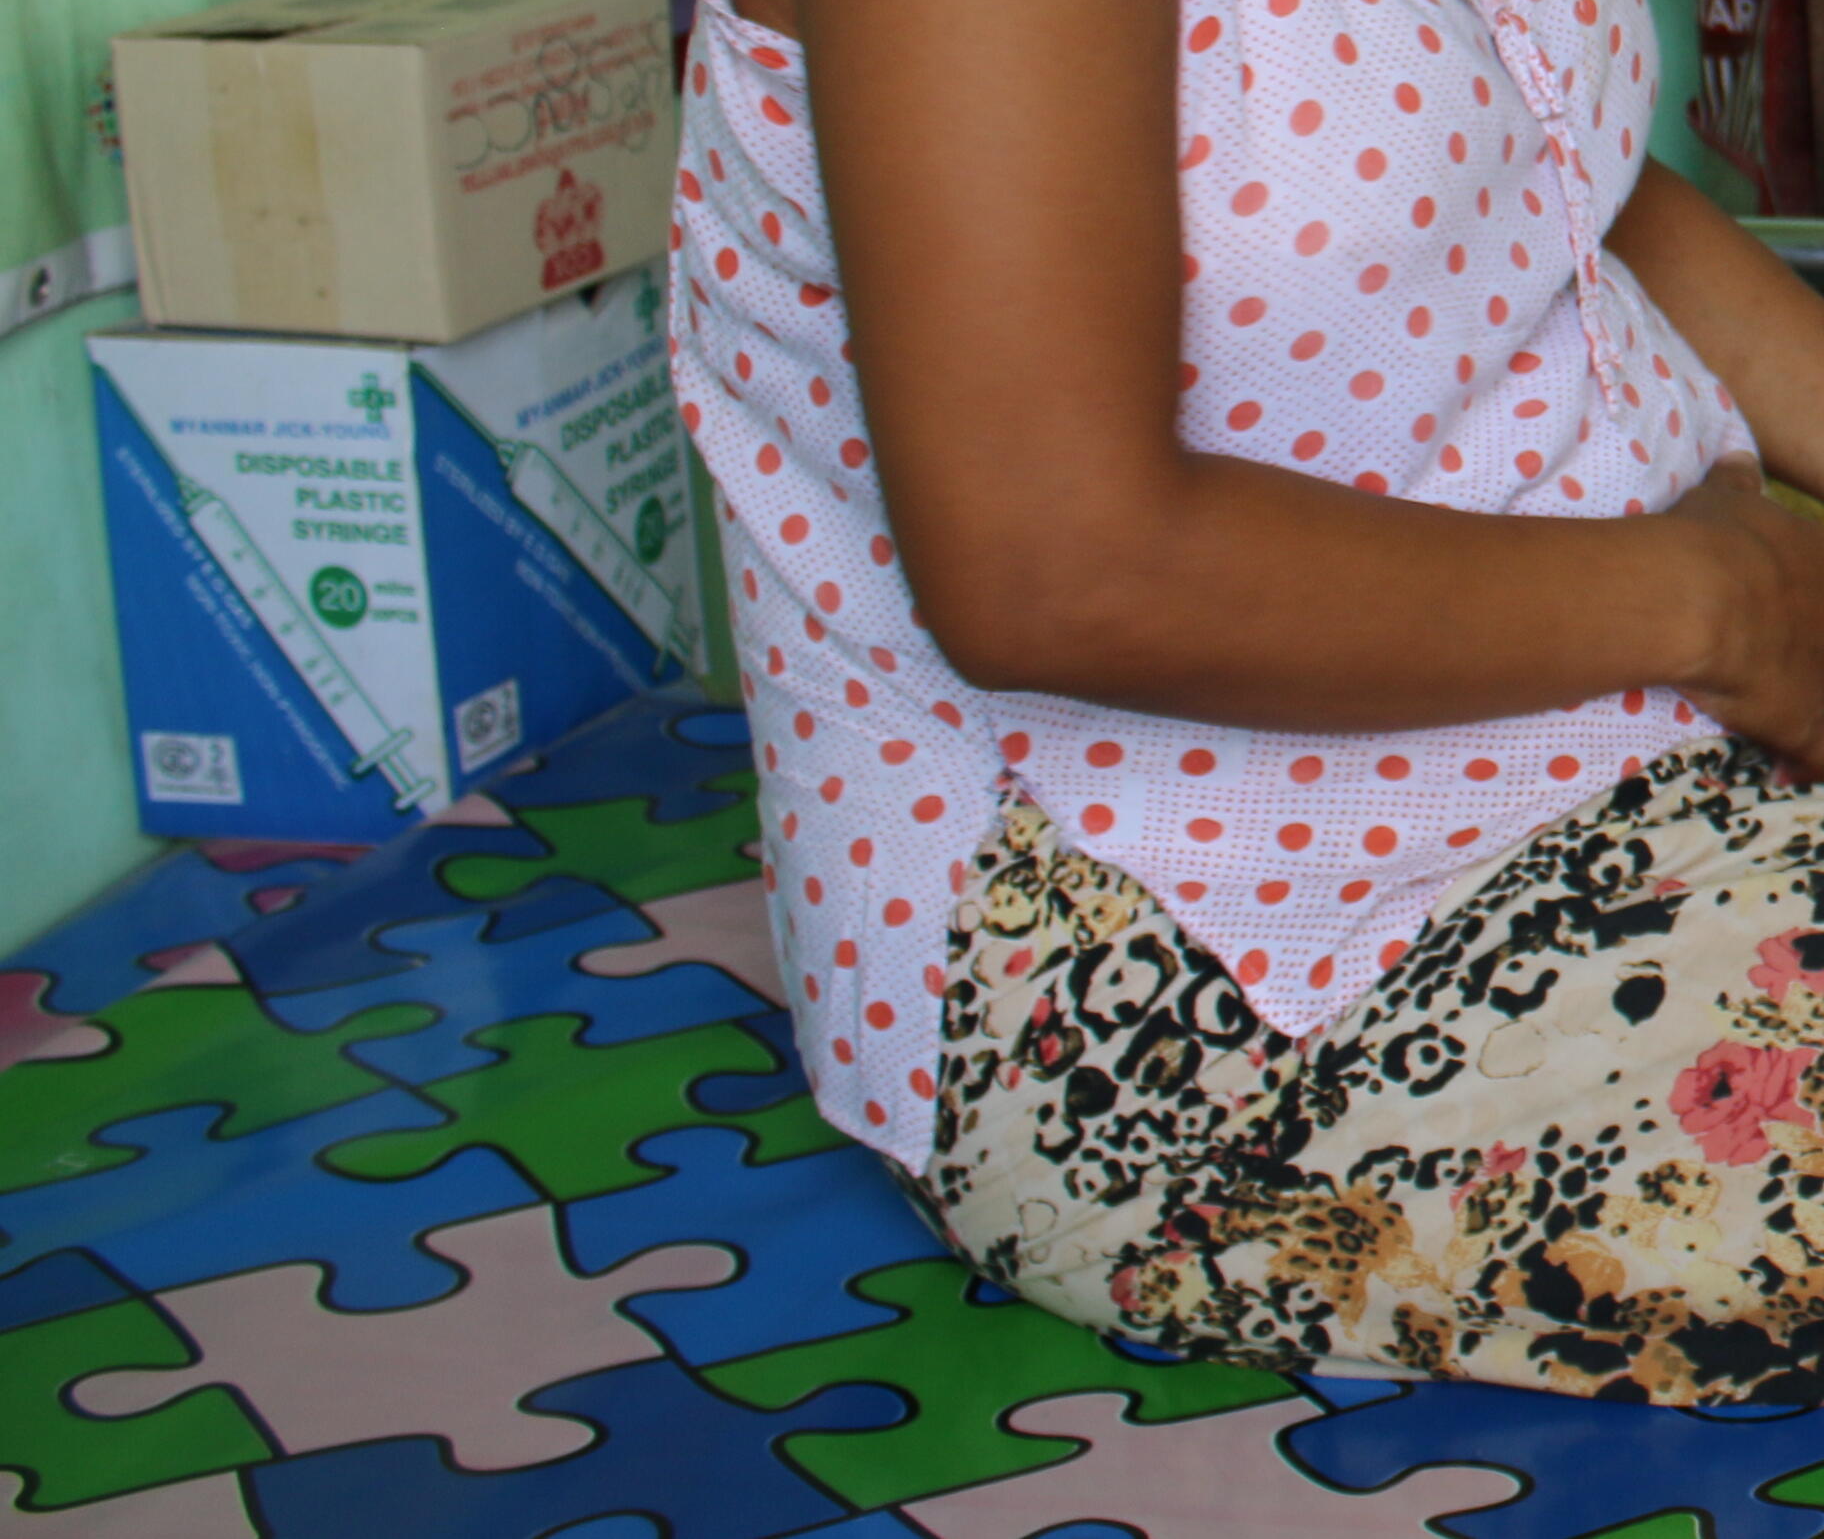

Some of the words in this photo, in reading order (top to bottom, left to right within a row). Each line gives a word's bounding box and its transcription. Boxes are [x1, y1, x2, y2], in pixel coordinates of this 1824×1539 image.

[234, 452, 405, 483] DISPOSABLE
[296, 485, 407, 513] PLASTIC
[292, 518, 411, 546] SYRINGE
[318, 578, 362, 613] 20
